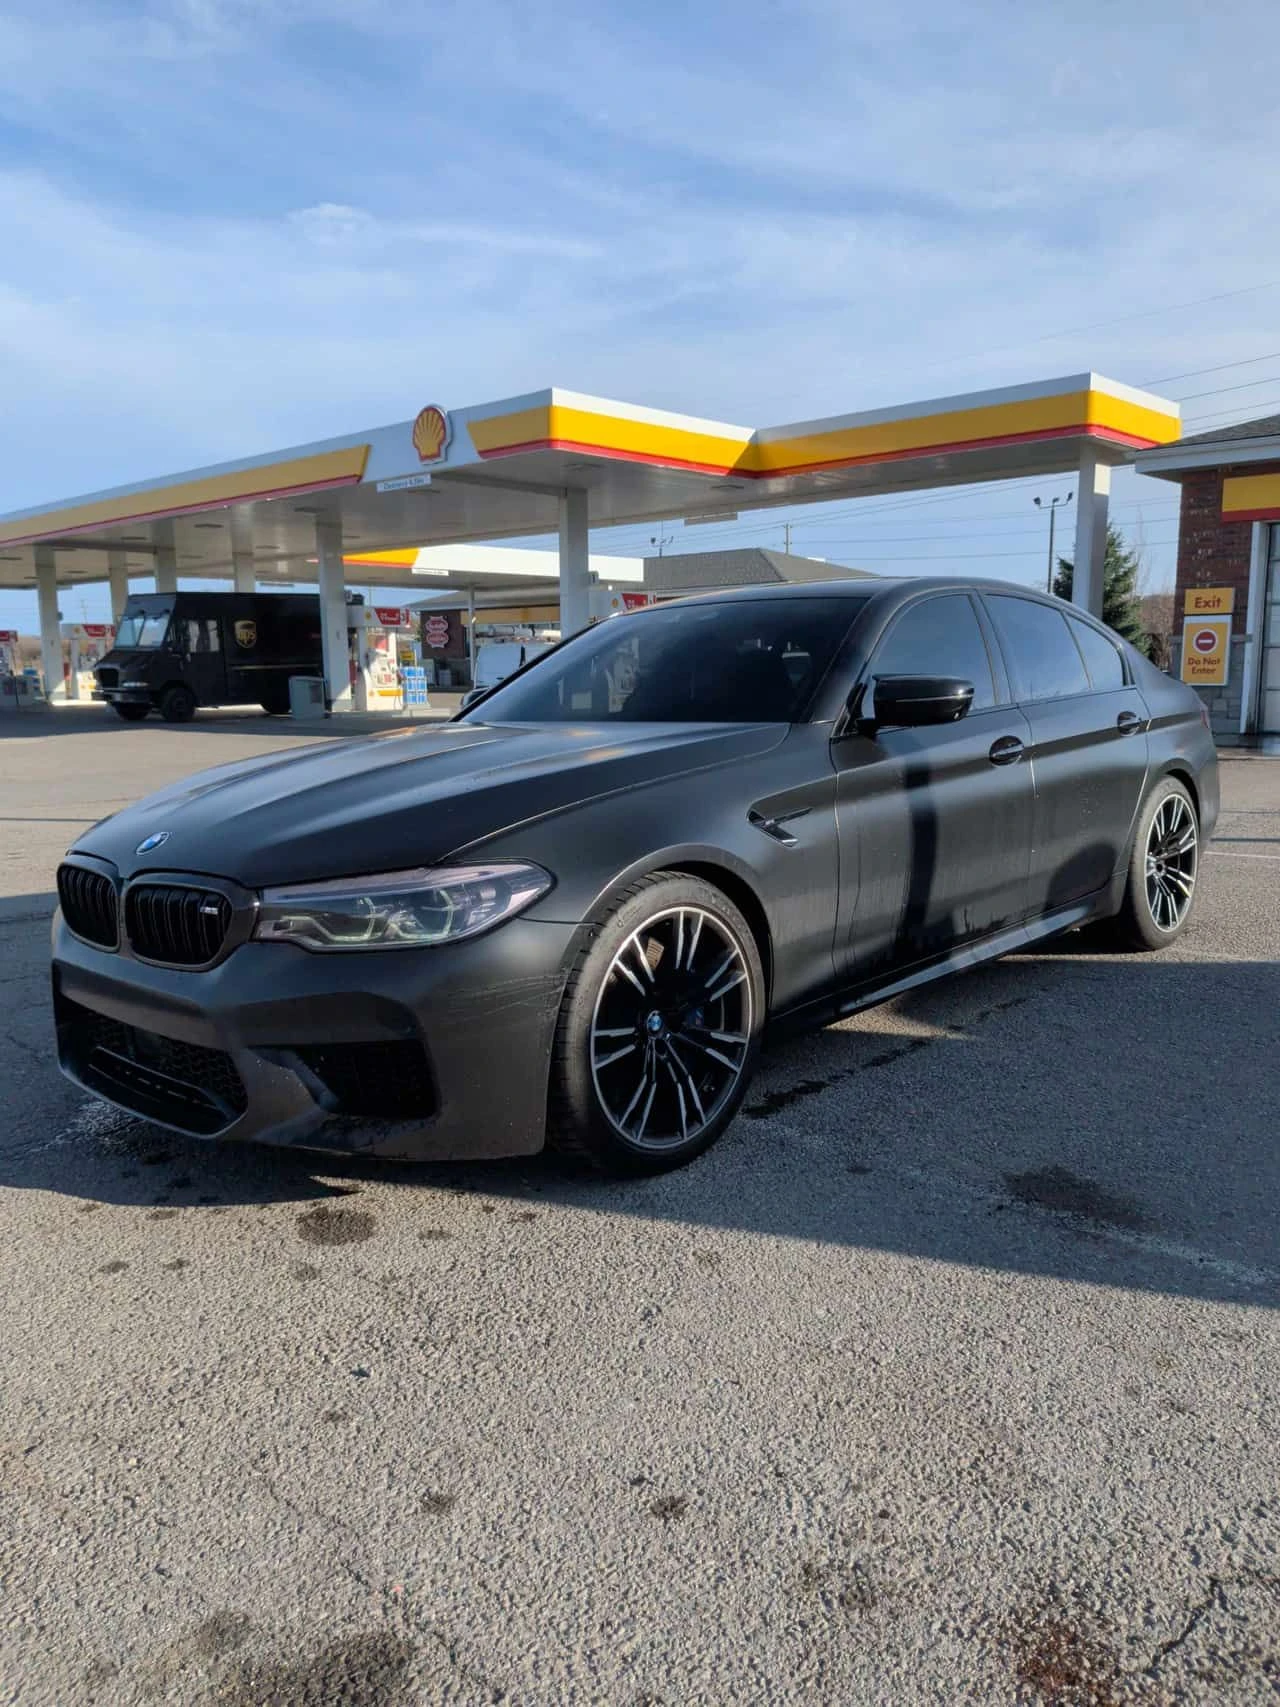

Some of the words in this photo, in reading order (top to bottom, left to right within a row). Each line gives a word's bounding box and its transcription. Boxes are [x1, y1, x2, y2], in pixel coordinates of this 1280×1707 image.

[1194, 596, 1222, 609] Exit
[1188, 657, 1201, 665] Do
[1203, 656, 1220, 665] Not
[1191, 666, 1217, 674] Enter
